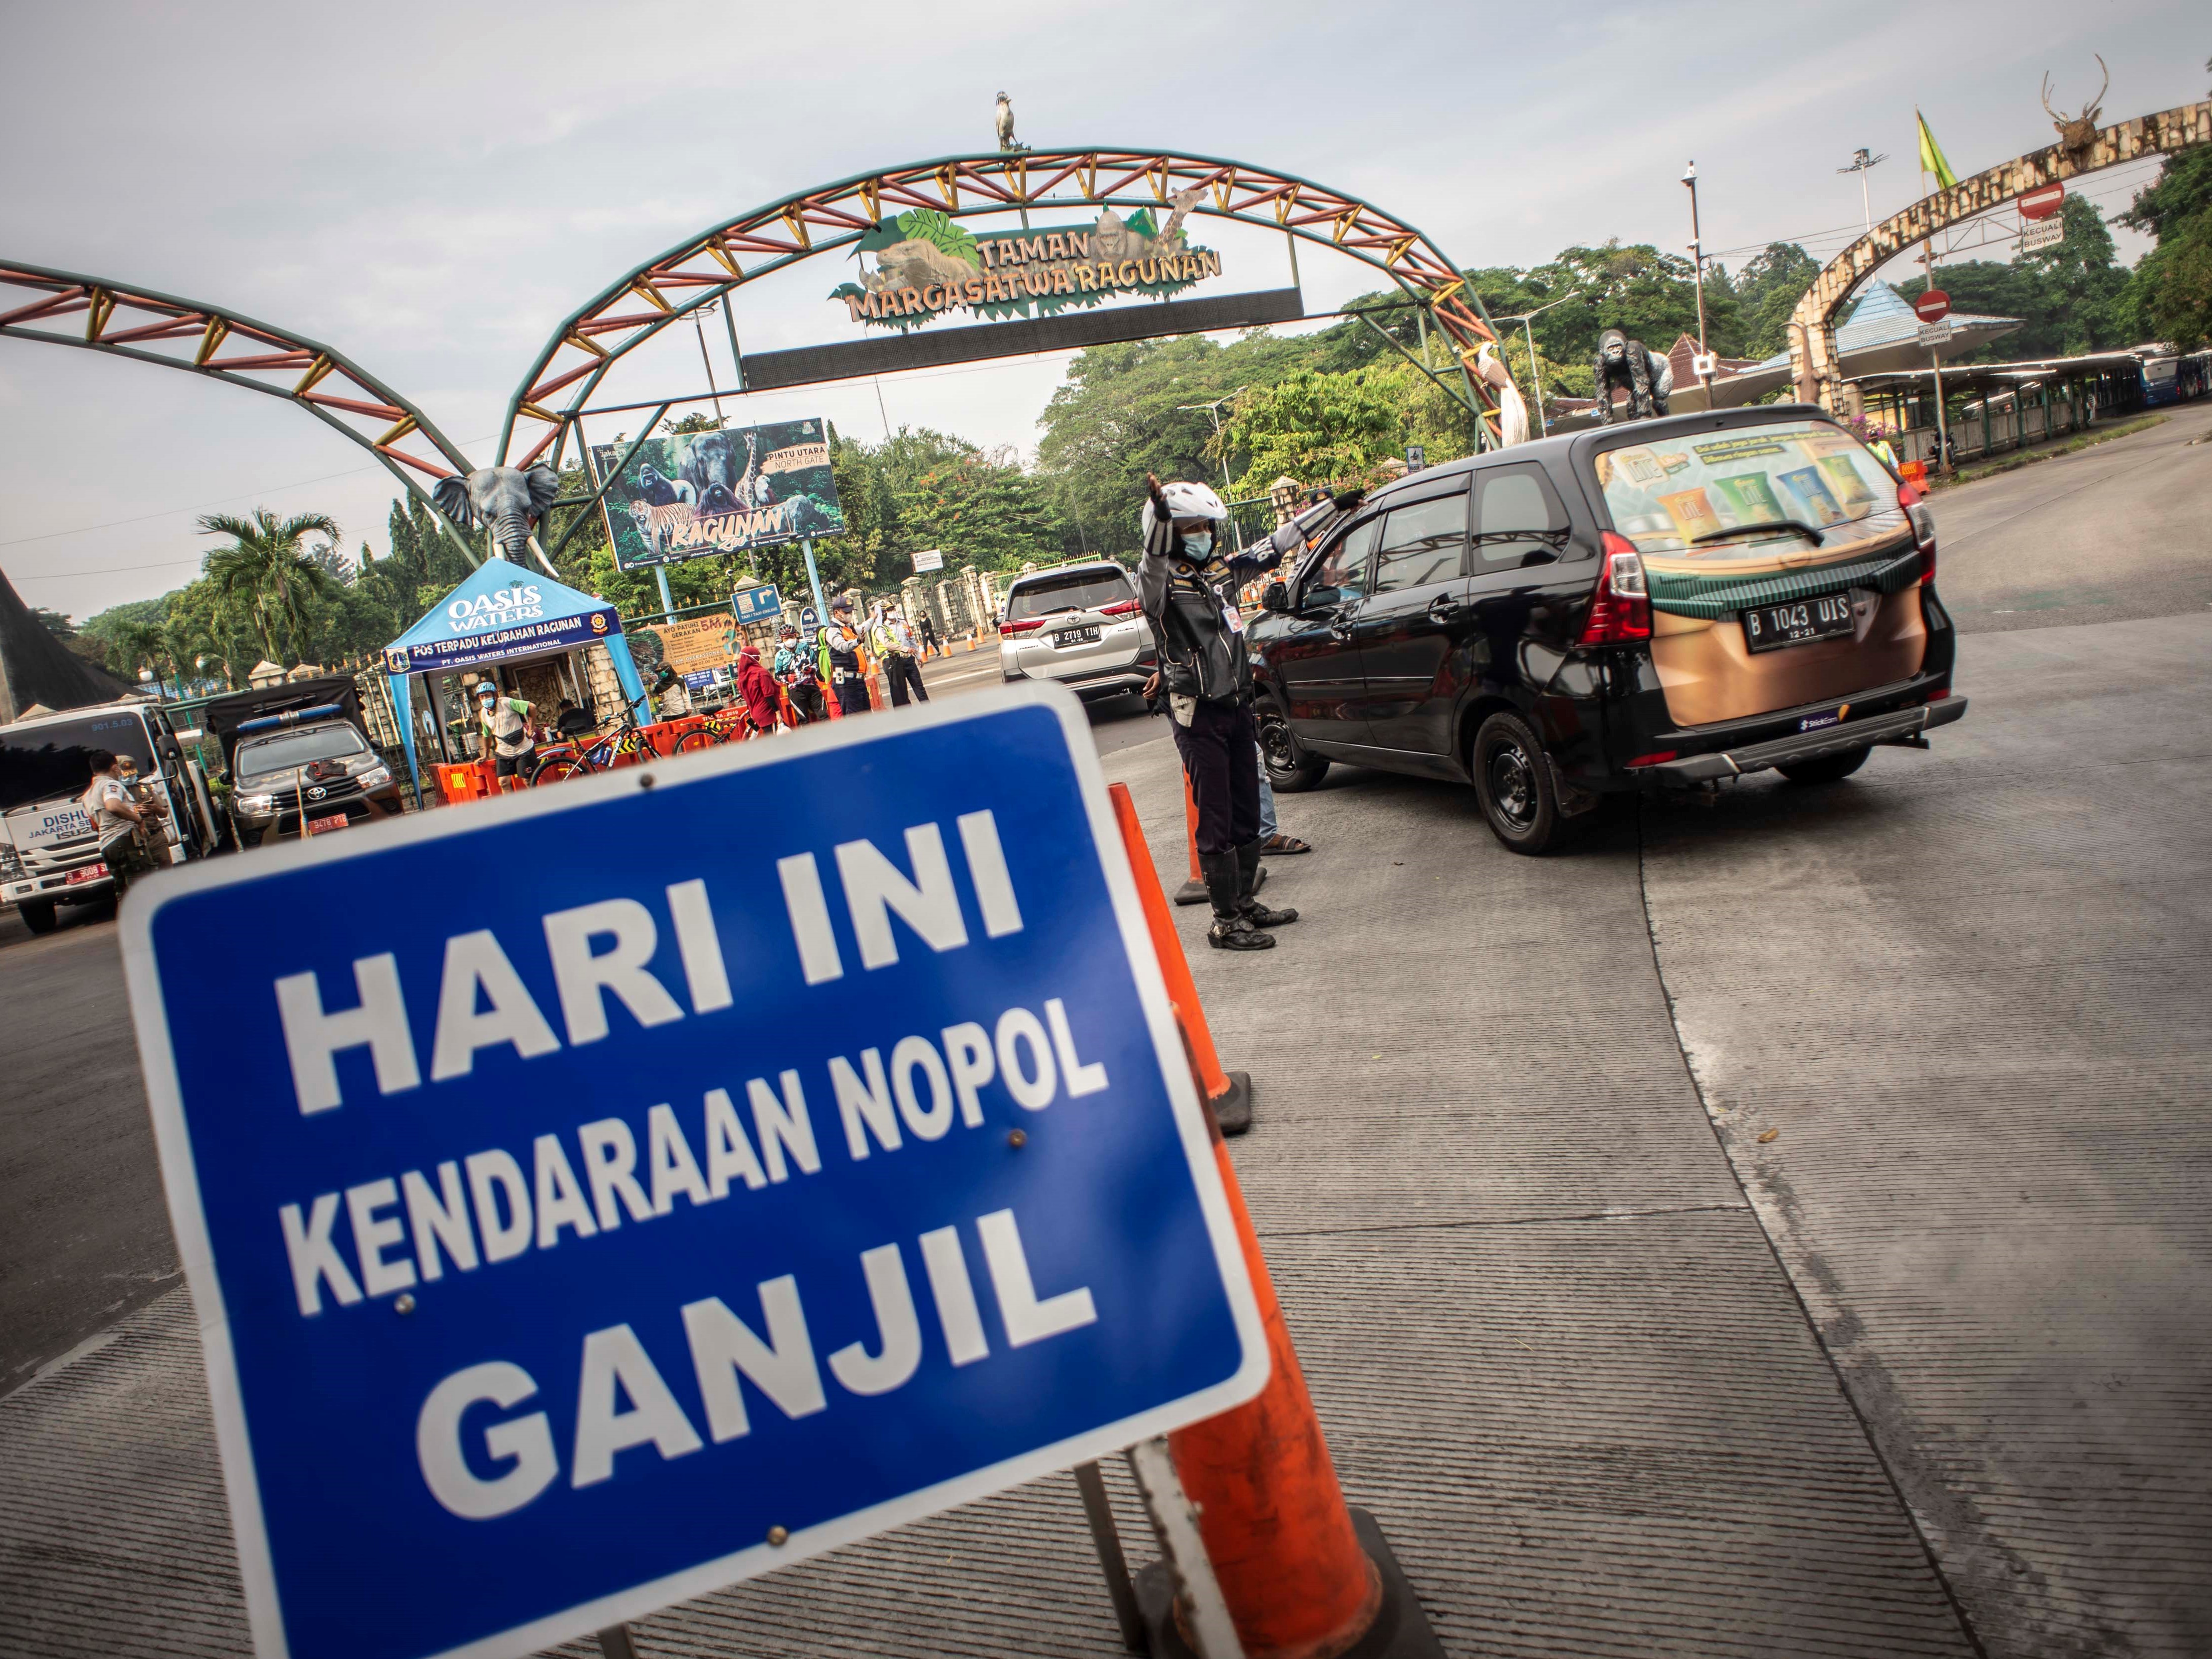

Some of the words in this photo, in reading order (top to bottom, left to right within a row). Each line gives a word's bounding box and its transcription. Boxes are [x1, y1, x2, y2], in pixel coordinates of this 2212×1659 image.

[2023, 222, 2062, 237] KECUALI
[2024, 233, 2062, 247] BUSWAY
[975, 231, 1090, 268] TAMAN
[845, 268, 1076, 323] MARGASATWA
[1074, 251, 1223, 292] RAGUNAN
[1920, 325, 1949, 335] KECUALI
[1921, 332, 1949, 342] BUSWAY
[769, 450, 795, 460] PINTU
[797, 446, 825, 456] UTARA
[775, 458, 802, 469] NORTH
[805, 456, 824, 464] GATE
[672, 508, 782, 547] RAGUNAN
[718, 534, 746, 551] Zoo
[448, 585, 542, 619] OASIS
[449, 605, 544, 633] WATERS
[677, 622, 699, 631] PATUHI
[701, 617, 722, 632] 5M
[1750, 614, 1761, 636] B
[1772, 605, 1809, 631] 1043
[1818, 598, 1849, 622] UIS
[414, 644, 434, 657] POS
[434, 637, 479, 654] TERPADU
[481, 626, 536, 647] KELURAHAN
[538, 617, 582, 636] RAGUNAN
[672, 628, 701, 638] GERAKAN
[1064, 630, 1081, 640] 2719
[1085, 627, 1098, 636] TIH
[1789, 627, 1815, 638] 12-21
[477, 650, 505, 660] WATERS
[506, 639, 562, 655] INTERNATIONAL
[92, 718, 133, 731] 901.5.03
[43, 810, 90, 827] DISHU
[29, 823, 76, 838] JAKARTA
[274, 879, 734, 1116] HARI
[776, 810, 1023, 986] INI
[279, 1069, 821, 1318] KENDARAAN
[830, 997, 1109, 1160] NOPOL
[416, 1208, 1098, 1521] GANJIL
